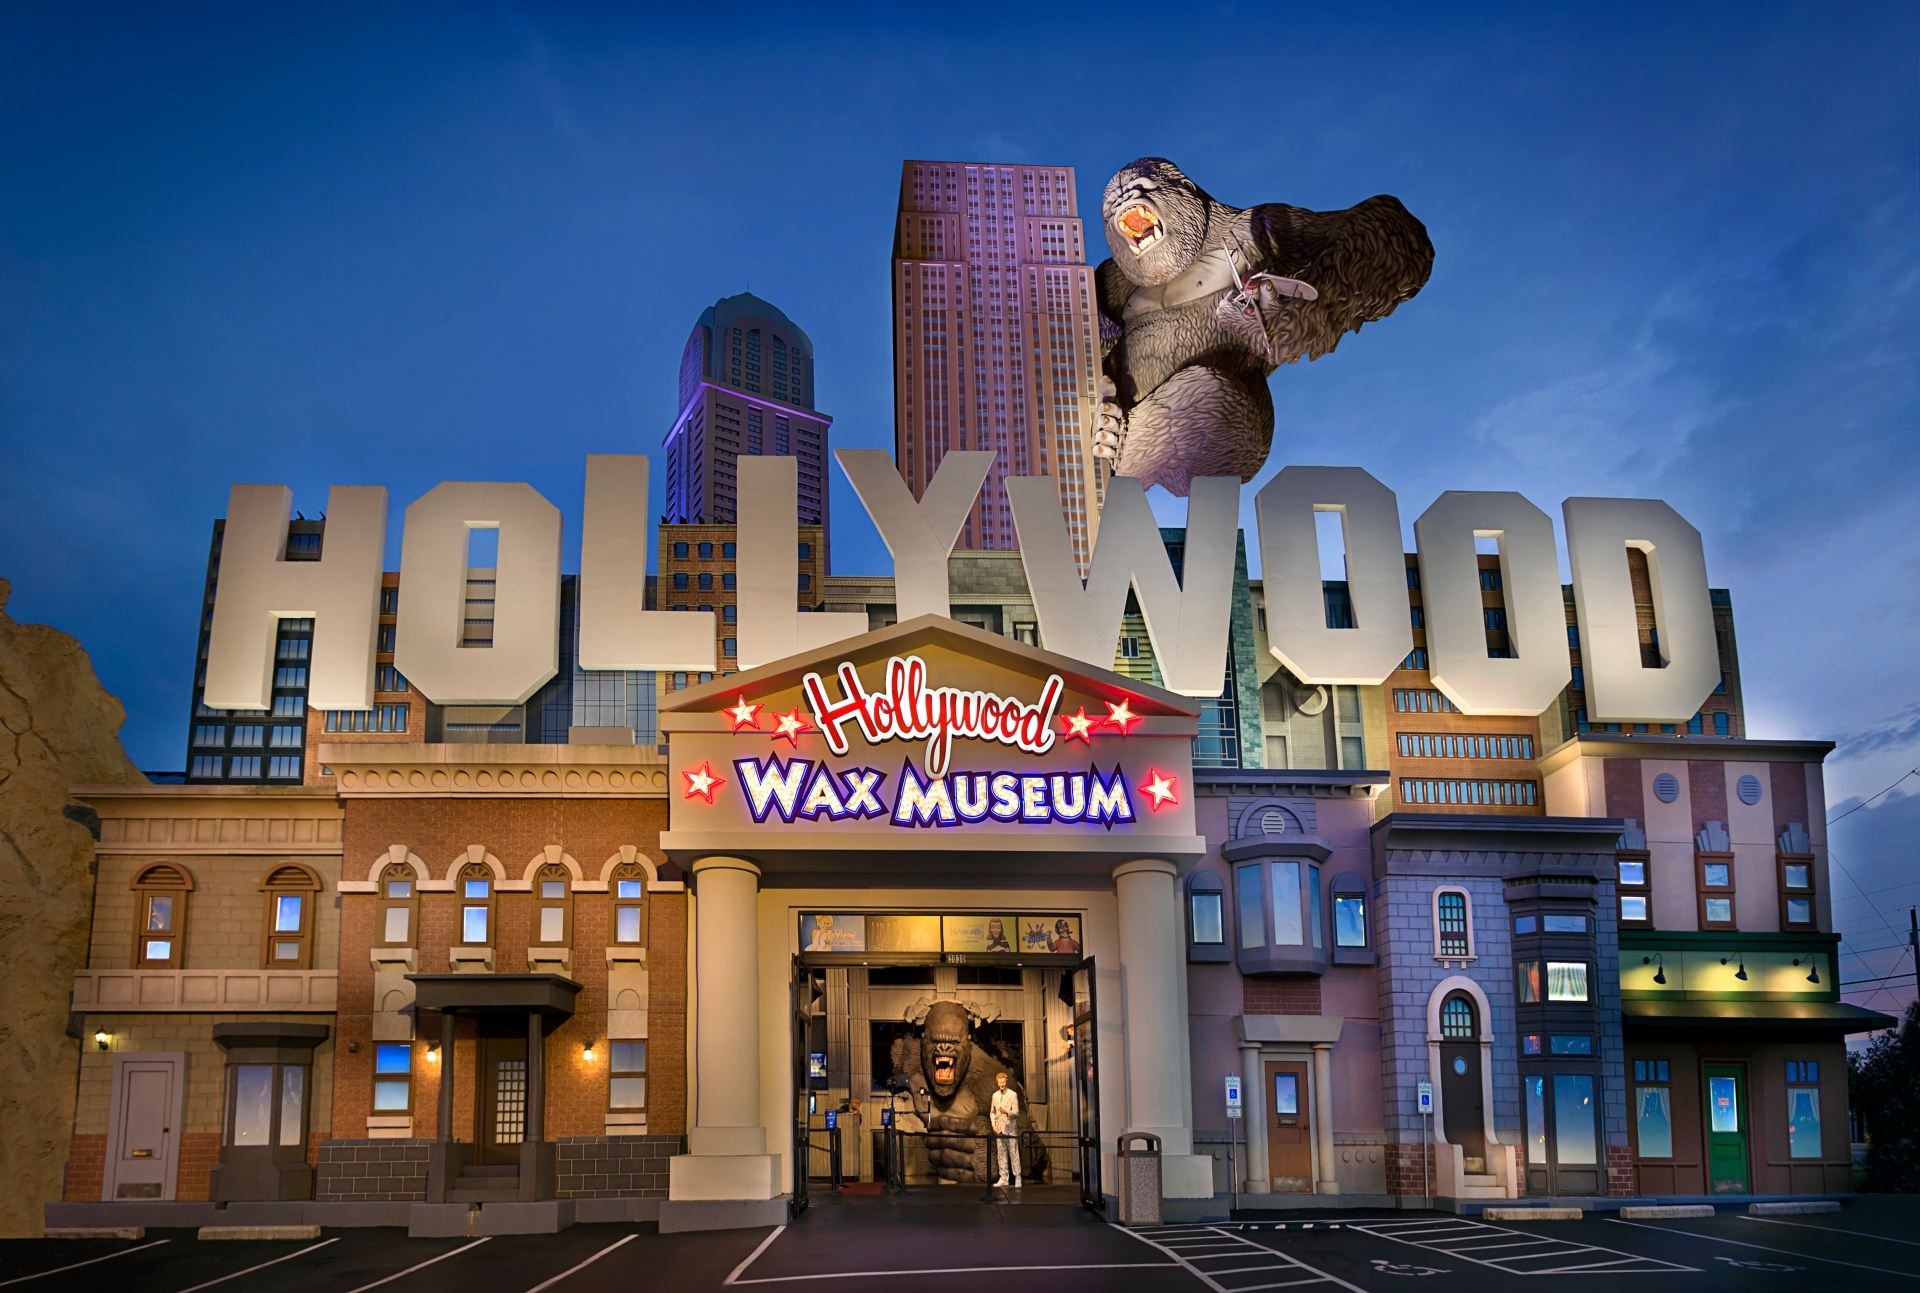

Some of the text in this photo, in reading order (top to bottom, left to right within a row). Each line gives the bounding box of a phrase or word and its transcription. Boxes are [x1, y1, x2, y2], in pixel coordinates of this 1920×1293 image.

[204, 449, 1721, 723] HOLLYWOOD
[803, 655, 1064, 779] Hollywood
[733, 751, 1137, 830] WAX MUSEUM
